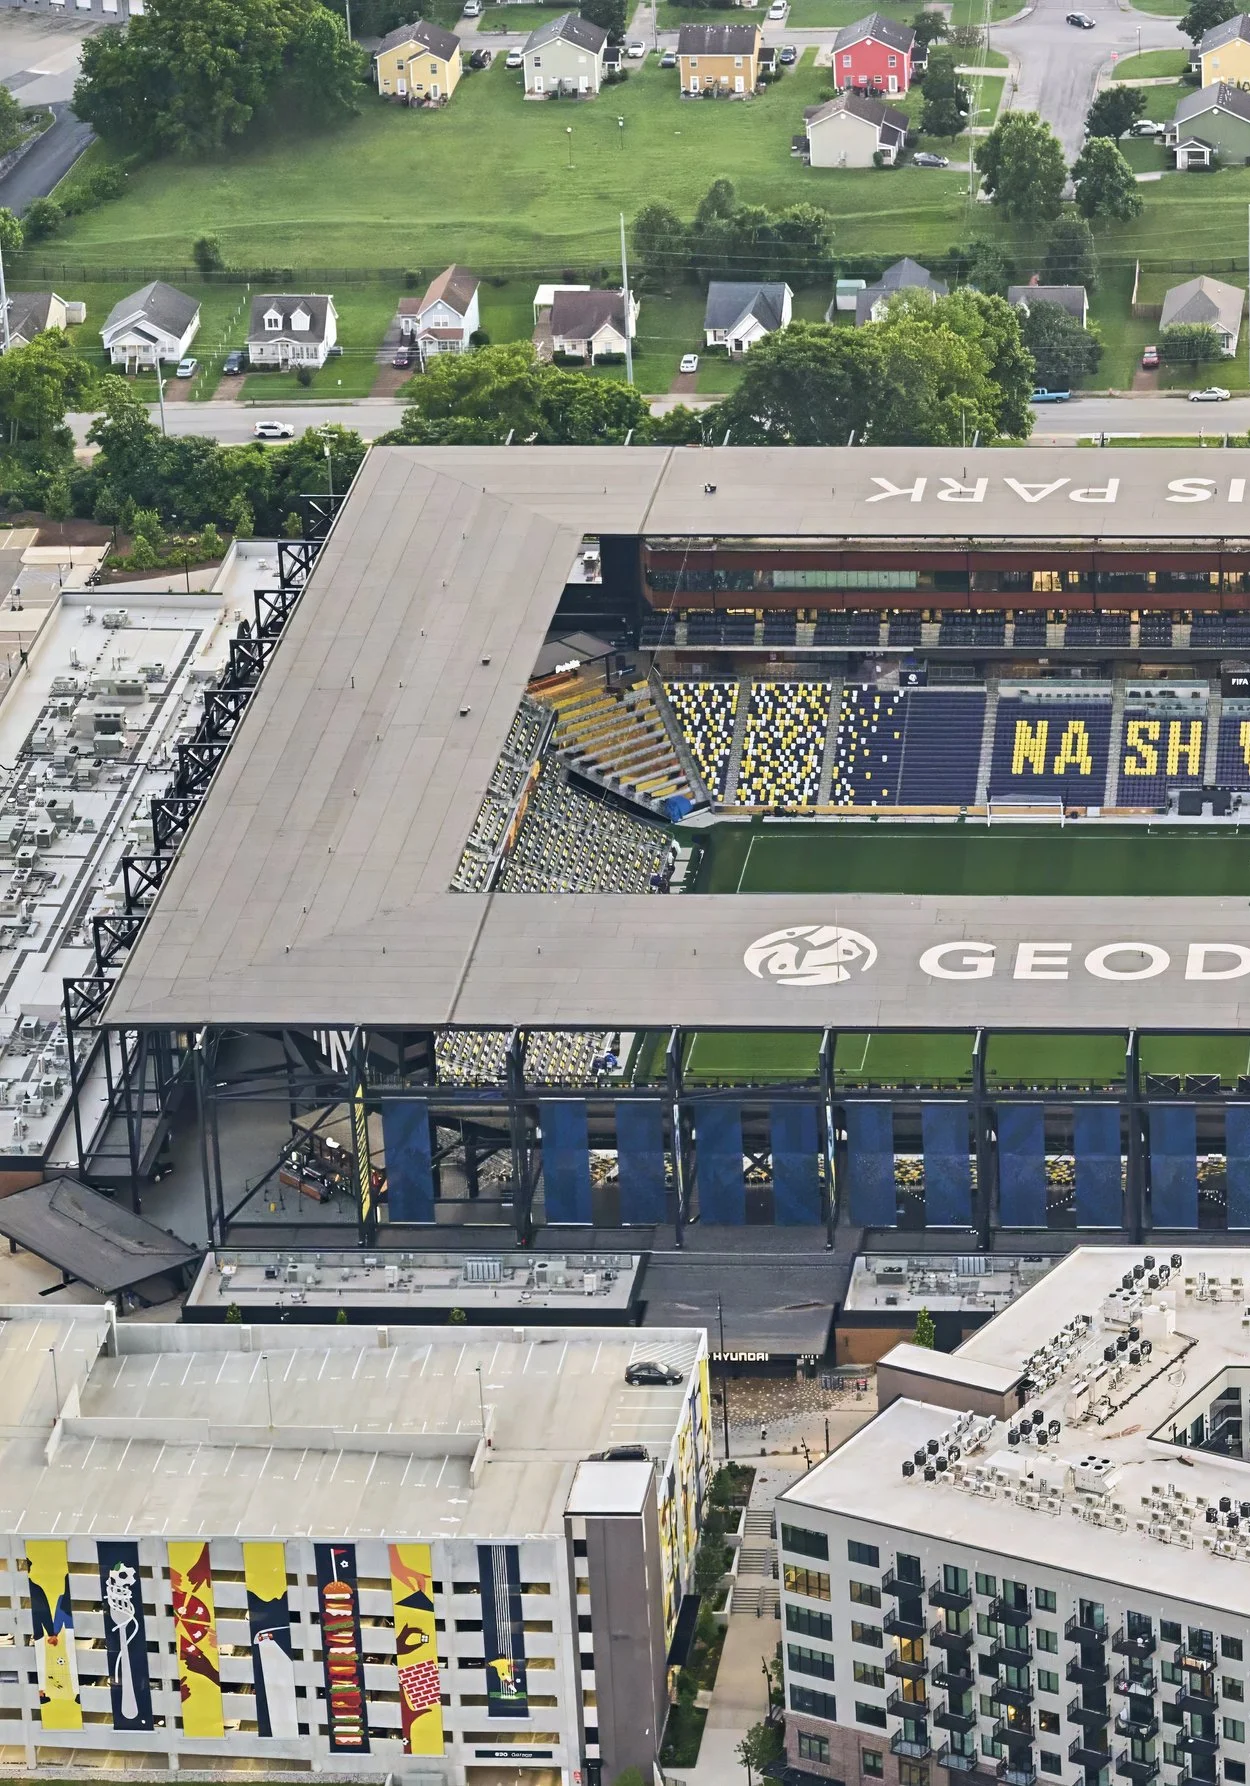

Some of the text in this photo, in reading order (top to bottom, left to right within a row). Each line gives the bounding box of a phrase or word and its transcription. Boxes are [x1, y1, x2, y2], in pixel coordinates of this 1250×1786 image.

[865, 476, 1121, 504] PARK
[1231, 678, 1249, 686] FIFA
[713, 1352, 769, 1361] HYUNDAI
